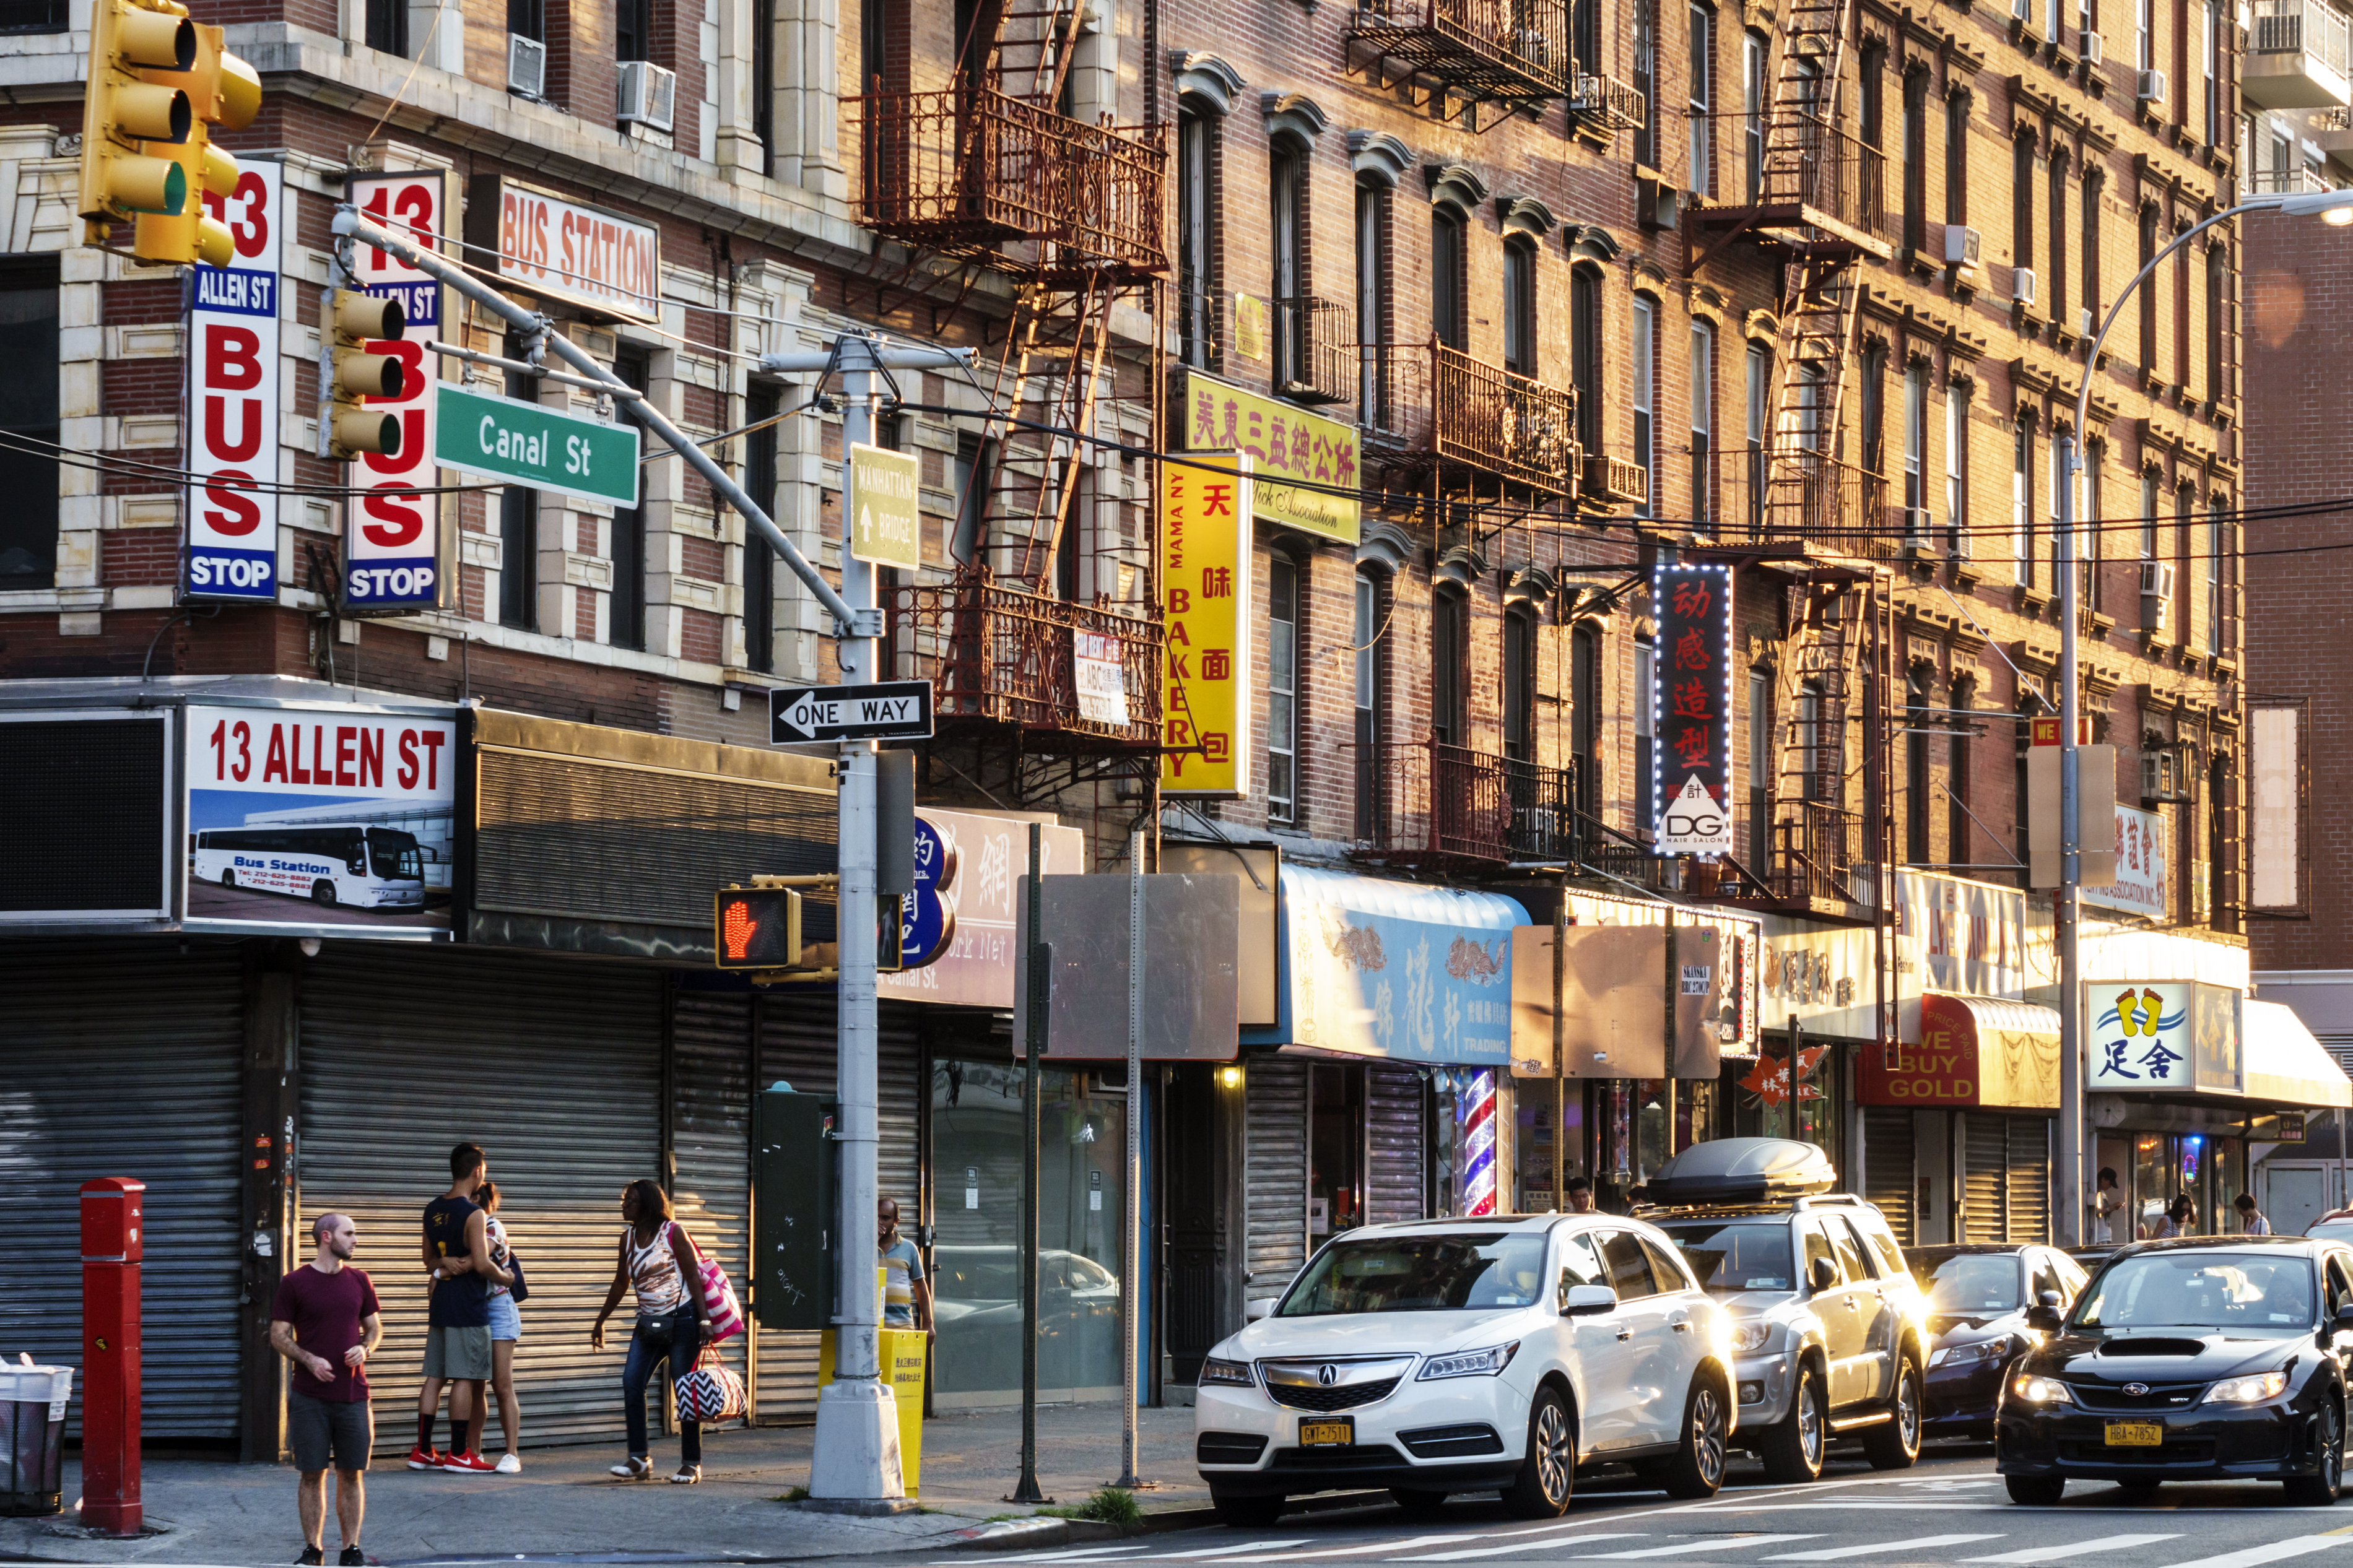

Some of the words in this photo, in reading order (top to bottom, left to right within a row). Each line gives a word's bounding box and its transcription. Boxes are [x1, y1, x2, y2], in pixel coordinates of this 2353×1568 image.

[362, 184, 433, 271] 13
[502, 192, 548, 279] BUS
[560, 210, 653, 309] STATION
[199, 271, 247, 308] ALLEN
[251, 276, 271, 310] ST
[414, 287, 435, 319] ST
[204, 324, 263, 537] BUS
[362, 340, 425, 547] BUS
[479, 415, 548, 467] Canal
[565, 435, 591, 477] St
[858, 464, 912, 500] MANHATTAN
[1170, 472, 1184, 498] NY
[1276, 487, 1338, 529] Association
[879, 512, 911, 544] BRIDGE
[1170, 505, 1183, 569] MAMA
[190, 555, 271, 587] STOP
[349, 567, 434, 597] STOP
[1201, 484, 1231, 764] 天味面包
[1076, 632, 1088, 657] FOR
[1089, 634, 1105, 660] RENT
[1087, 663, 1103, 692] ABC
[1167, 587, 1191, 778] BAKERY
[795, 703, 839, 726] ONE
[861, 700, 910, 722] WAY
[2037, 723, 2055, 740] WE
[210, 719, 251, 782] 13
[263, 722, 385, 788] ALLEN
[397, 728, 445, 790] ST
[1666, 814, 1723, 836] DG
[234, 855, 265, 868] Bus
[270, 859, 330, 875] Station
[254, 871, 311, 882] 212-625-8882
[947, 929, 972, 959] ork
[979, 931, 1006, 967] Net
[887, 968, 920, 987] Canal
[923, 965, 939, 989] St.
[1682, 981, 1692, 993] BRC
[1683, 966, 1707, 978] SKANSKA
[1463, 1037, 1507, 1054] TRADING
[1908, 1031, 1951, 1050] WE
[1927, 1011, 1961, 1033] PRICE
[1958, 1033, 1973, 1060] PAID
[1898, 1055, 1959, 1073] BUY
[2098, 1038, 2184, 1080] 足舍
[1889, 1079, 1973, 1098] GOLD
[1305, 1426, 1320, 1441] GWT
[1326, 1426, 1347, 1440] 7511
[2110, 1426, 2127, 1440] HBA
[2134, 1426, 2156, 1440] 7852
